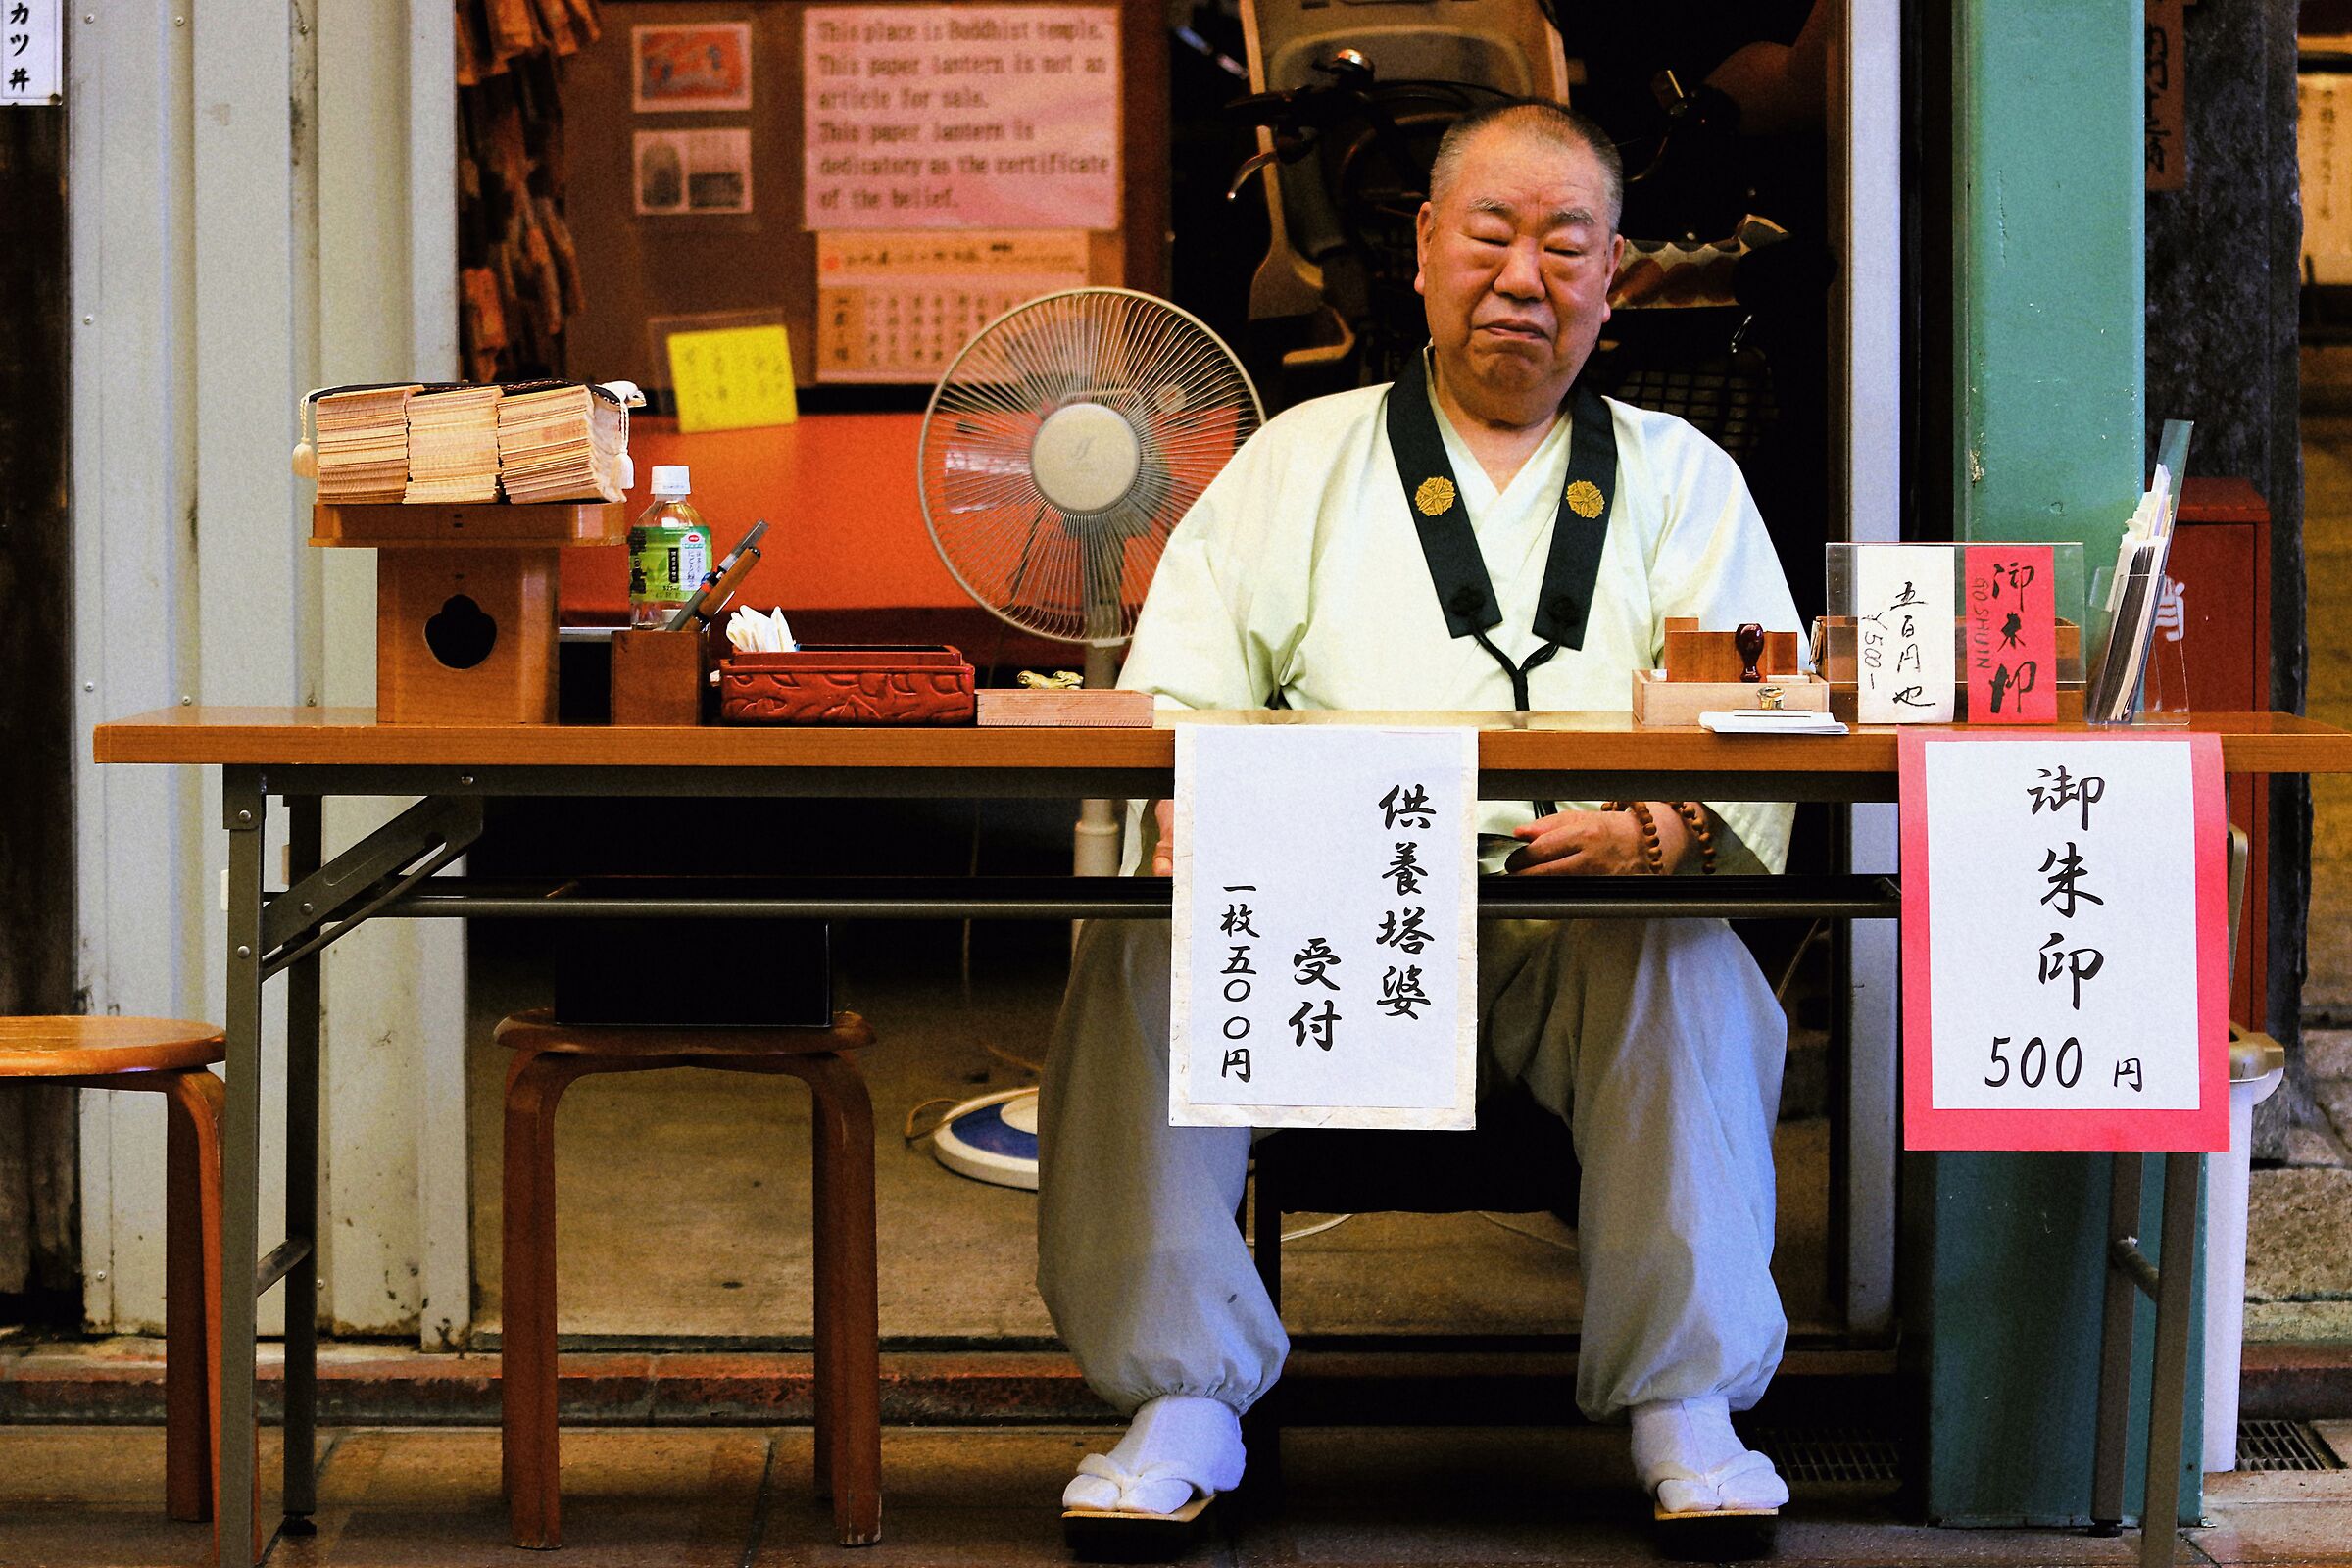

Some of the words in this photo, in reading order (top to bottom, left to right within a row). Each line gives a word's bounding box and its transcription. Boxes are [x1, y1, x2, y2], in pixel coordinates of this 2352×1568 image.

[818, 21, 858, 41] This
[862, 20, 915, 42] place
[923, 20, 943, 41] is
[949, 19, 1029, 40] Buddhist
[818, 54, 858, 75] This
[868, 58, 919, 77] paper
[932, 54, 1004, 74] lantern
[1013, 54, 1034, 74] is
[1041, 55, 1072, 74] not
[1085, 57, 1106, 74] an
[818, 85, 891, 109] article
[900, 86, 929, 108] for
[818, 122, 858, 142] This
[871, 124, 920, 145] paper
[933, 121, 1004, 141] lantern
[1013, 121, 1034, 141] is
[819, 156, 922, 177] dedicatory
[930, 158, 951, 174] as
[957, 155, 989, 174] the
[995, 153, 1110, 175] certificate
[819, 188, 841, 209] of
[851, 188, 879, 209] the
[2027, 764, 2105, 1010] 御朱印
[1376, 783, 1437, 1021] 供養塔婆
[1288, 937, 1342, 1052] 受付
